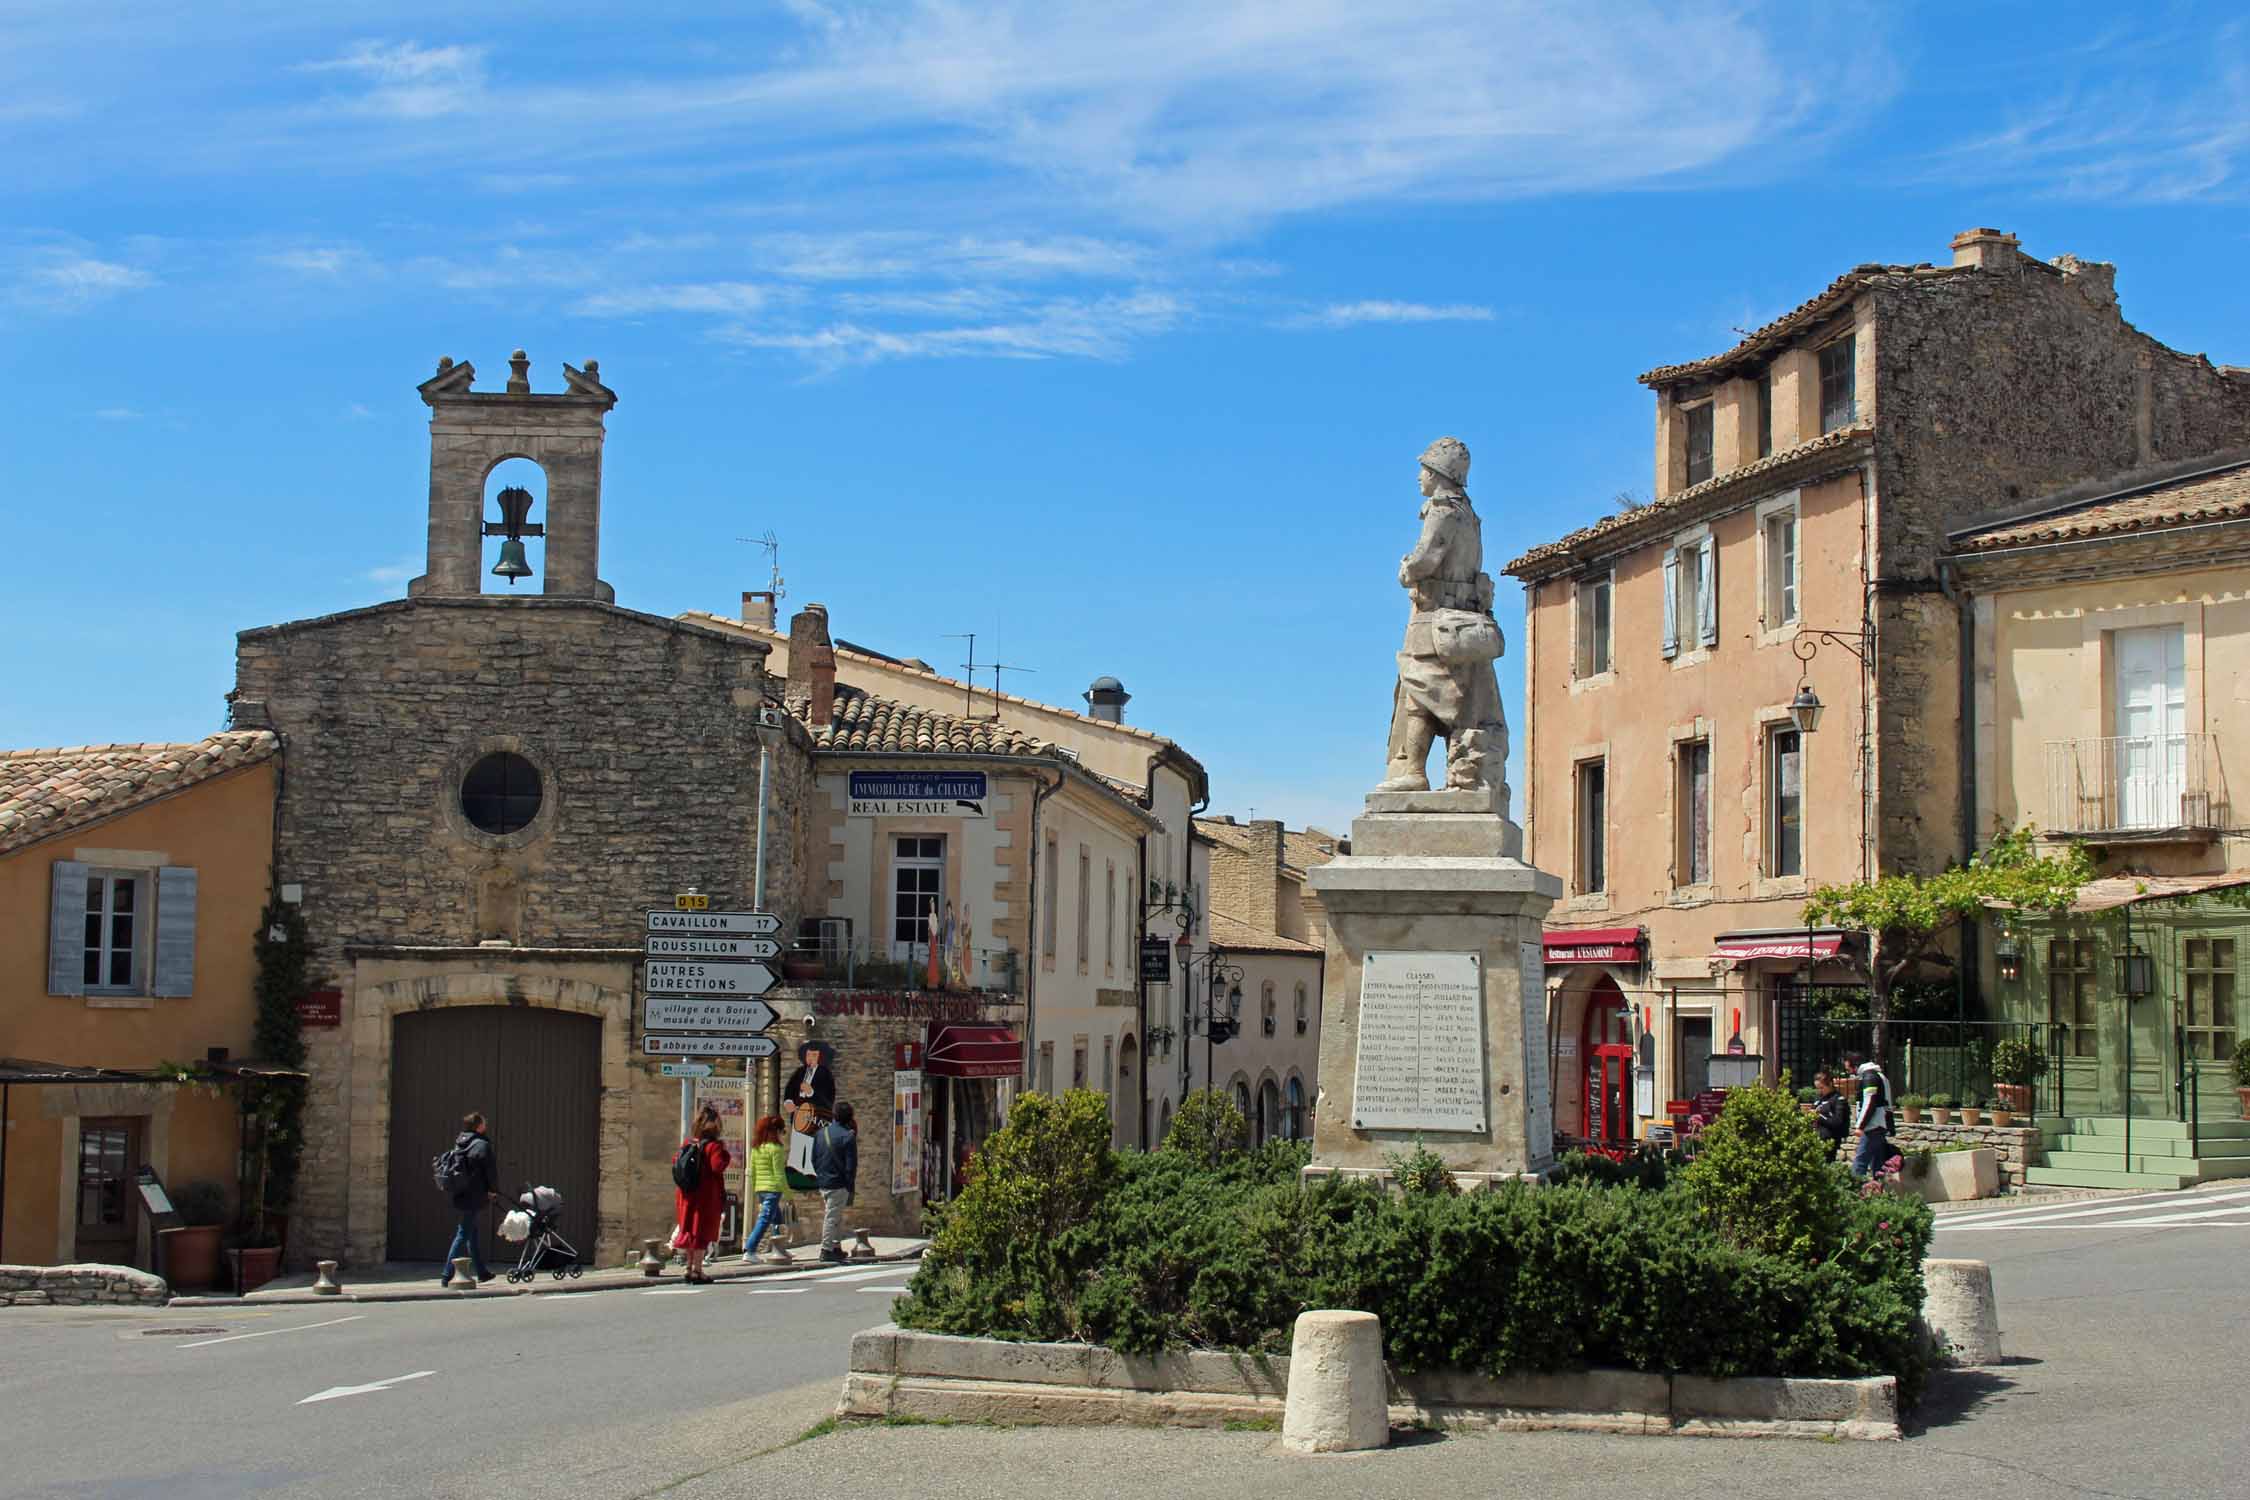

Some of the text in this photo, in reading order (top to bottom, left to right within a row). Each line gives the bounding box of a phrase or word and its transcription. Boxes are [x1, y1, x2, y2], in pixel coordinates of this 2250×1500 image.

[852, 802, 949, 813] REAL ESTATE
[679, 897, 705, 907] D 15
[652, 917, 769, 928] CAVAILLON 17
[652, 941, 768, 953] ROUSSILLON 12
[651, 966, 705, 976] AUTRES
[650, 979, 736, 990] DIRECTIONS
[664, 1006, 698, 1016] village
[726, 1007, 758, 1015] Bories
[700, 1017, 712, 1025] du
[717, 1017, 750, 1025] Vitrail
[663, 1041, 698, 1051] abbaye
[703, 1042, 715, 1050] de
[700, 1080, 743, 1089] Santons
